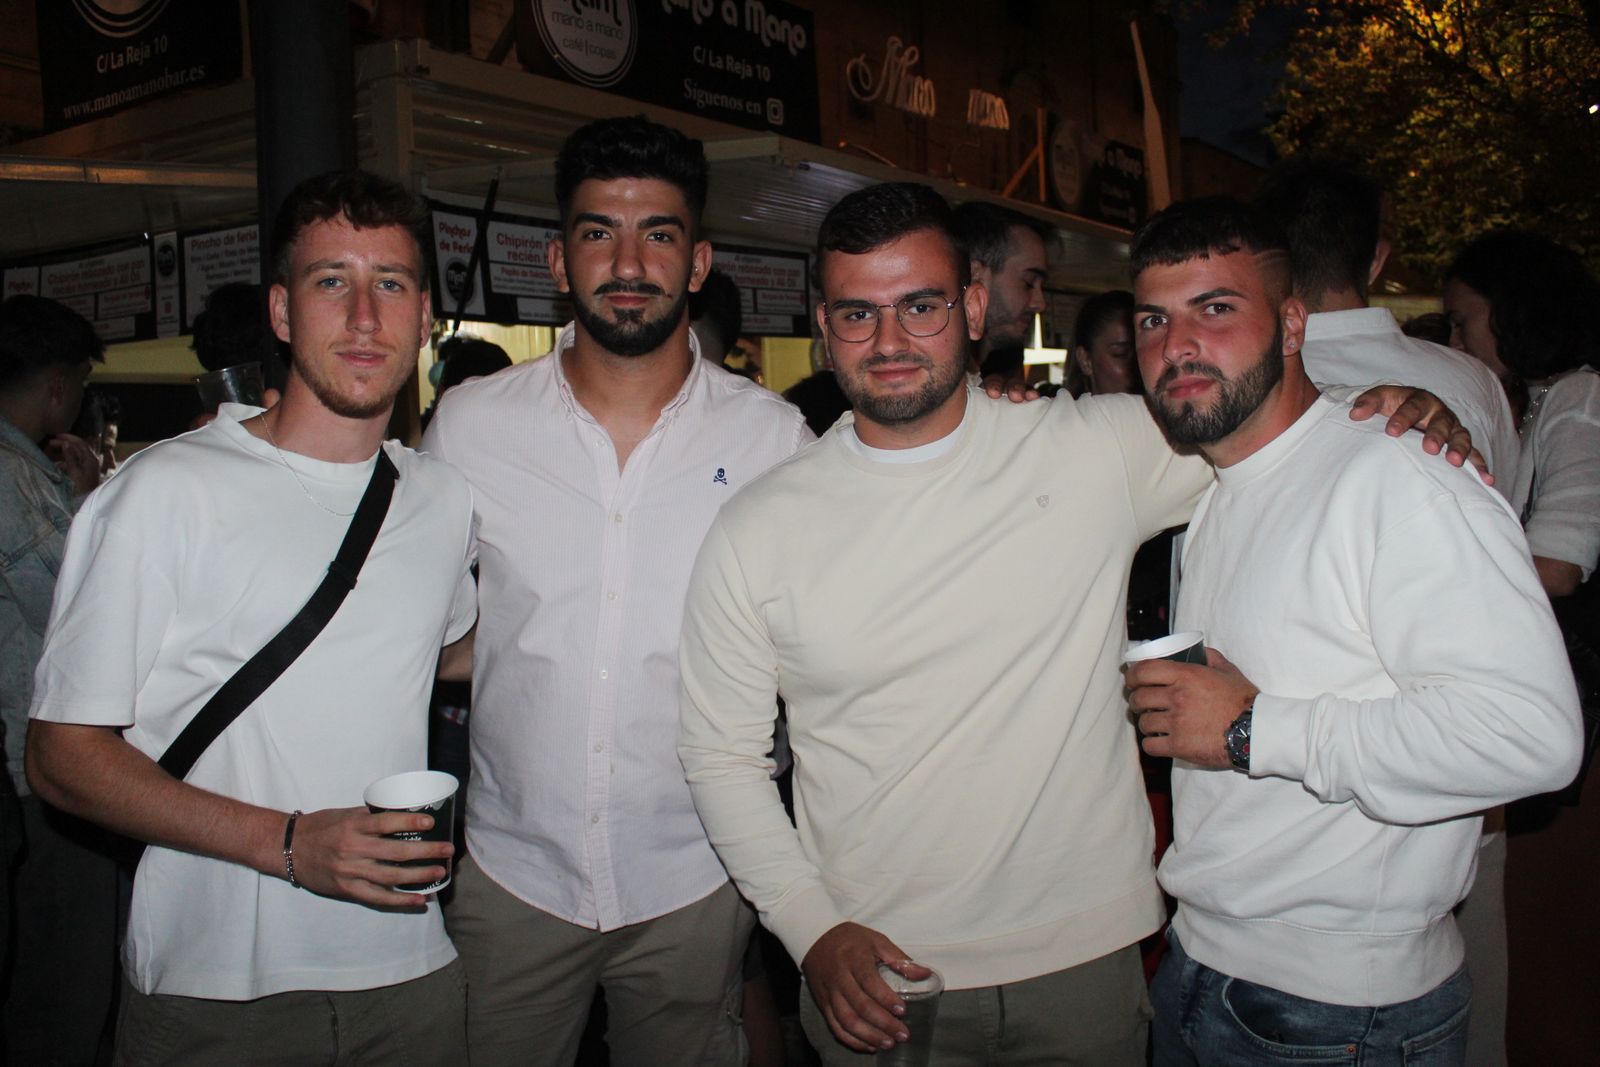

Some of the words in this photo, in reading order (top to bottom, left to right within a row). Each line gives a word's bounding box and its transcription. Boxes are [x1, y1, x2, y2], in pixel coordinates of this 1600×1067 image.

[552, 11, 584, 29] mano
[585, 19, 592, 32] a
[595, 22, 624, 41] mano
[745, 0, 807, 56] Mano
[111, 52, 124, 69] La
[126, 41, 150, 66] Reja
[153, 34, 168, 55] 10
[708, 49, 723, 70] La
[726, 53, 753, 80] Reja
[755, 63, 771, 83] 10
[63, 64, 206, 121] www.manoamanobar.es
[745, 100, 762, 115] en
[439, 240, 450, 252] de
[496, 232, 543, 249] Chipirón
[507, 249, 540, 264] recién
